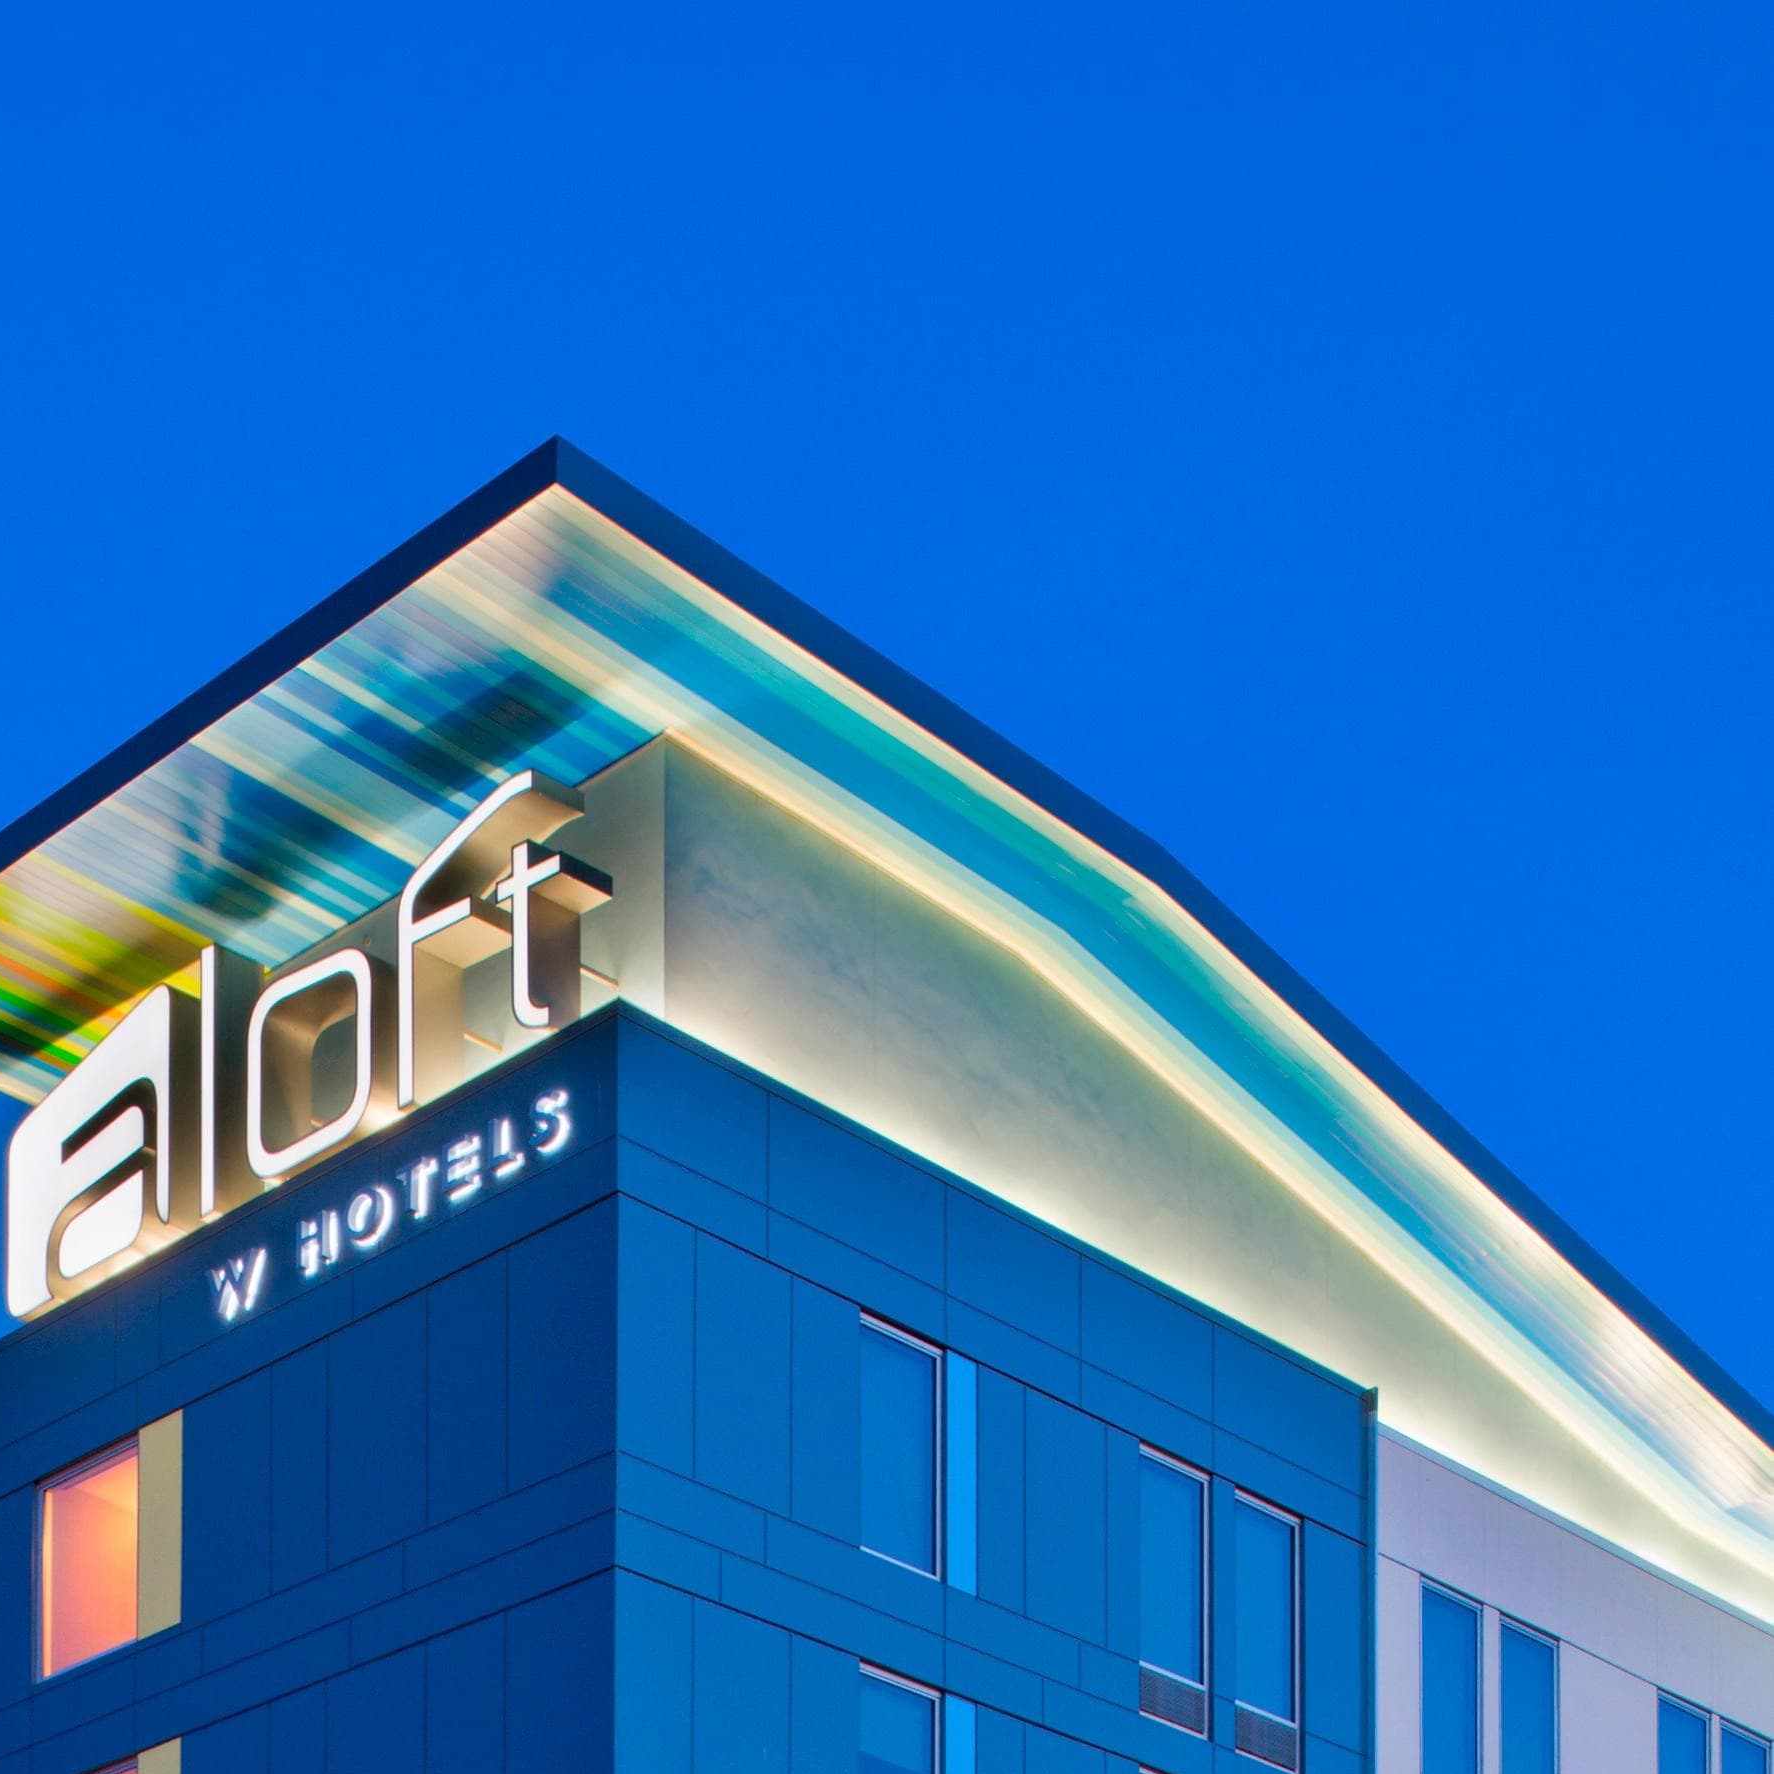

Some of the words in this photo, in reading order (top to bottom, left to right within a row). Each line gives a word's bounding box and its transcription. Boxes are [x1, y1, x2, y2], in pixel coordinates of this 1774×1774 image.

[8, 769, 561, 1319] aloft
[208, 1249, 266, 1321] W
[298, 1088, 571, 1277] HOTELS
